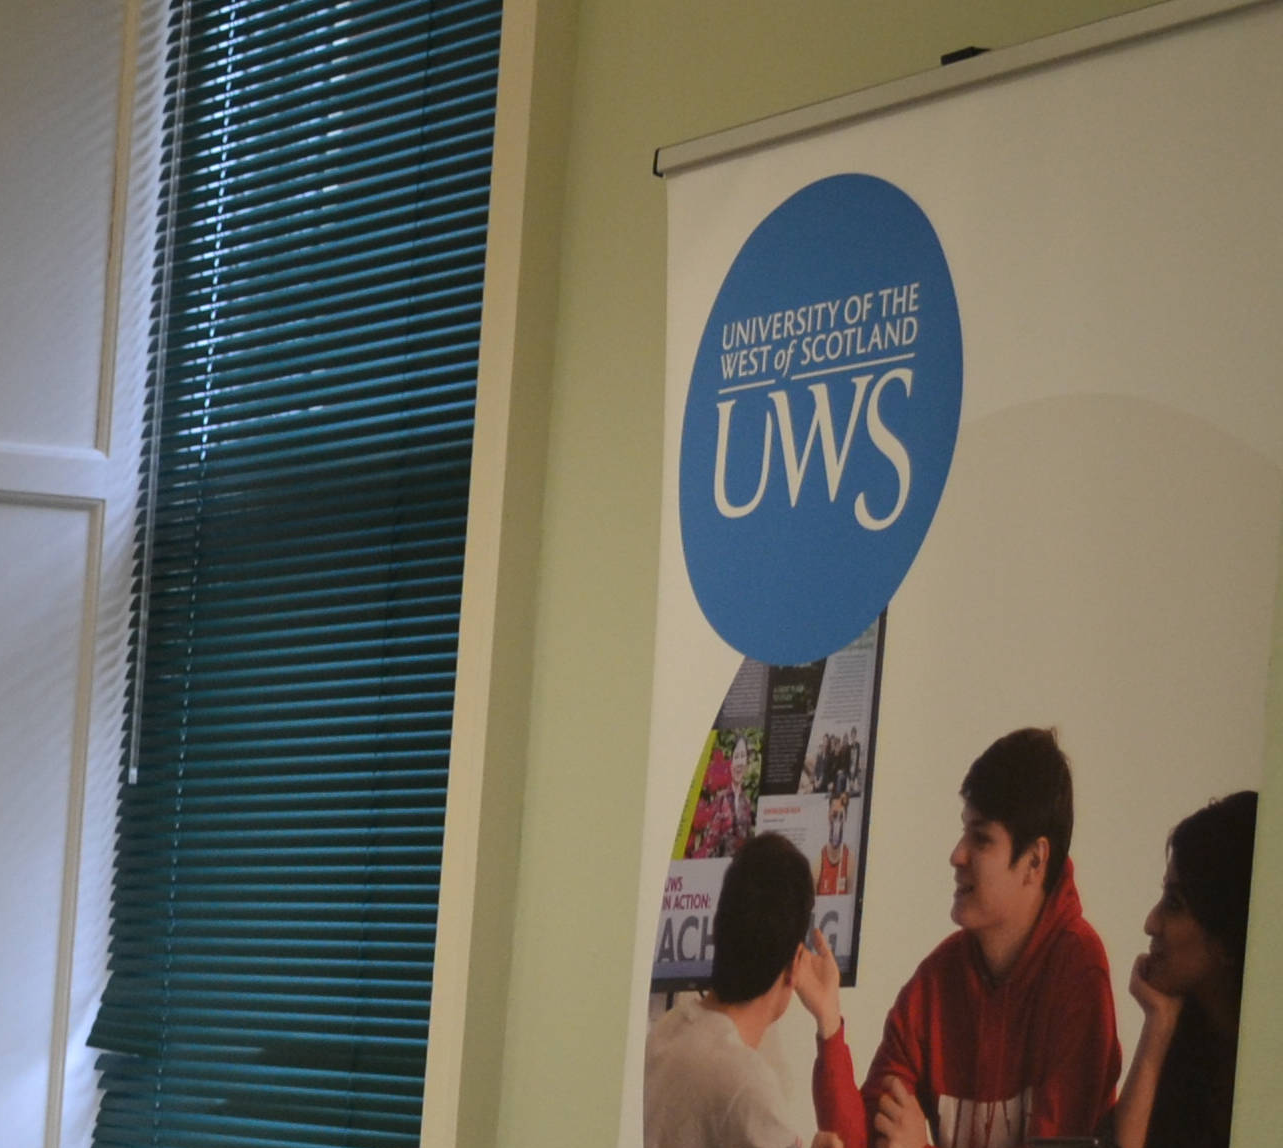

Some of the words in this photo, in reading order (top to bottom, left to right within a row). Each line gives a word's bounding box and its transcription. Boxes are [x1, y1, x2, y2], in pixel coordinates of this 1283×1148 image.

[721, 345, 772, 380] WEST
[774, 339, 796, 376] of
[800, 316, 918, 366] SCOTLAND
[722, 300, 840, 350] UNIVERSITY
[844, 292, 874, 325] OF
[879, 282, 920, 318] THE
[714, 367, 913, 531] UWS
